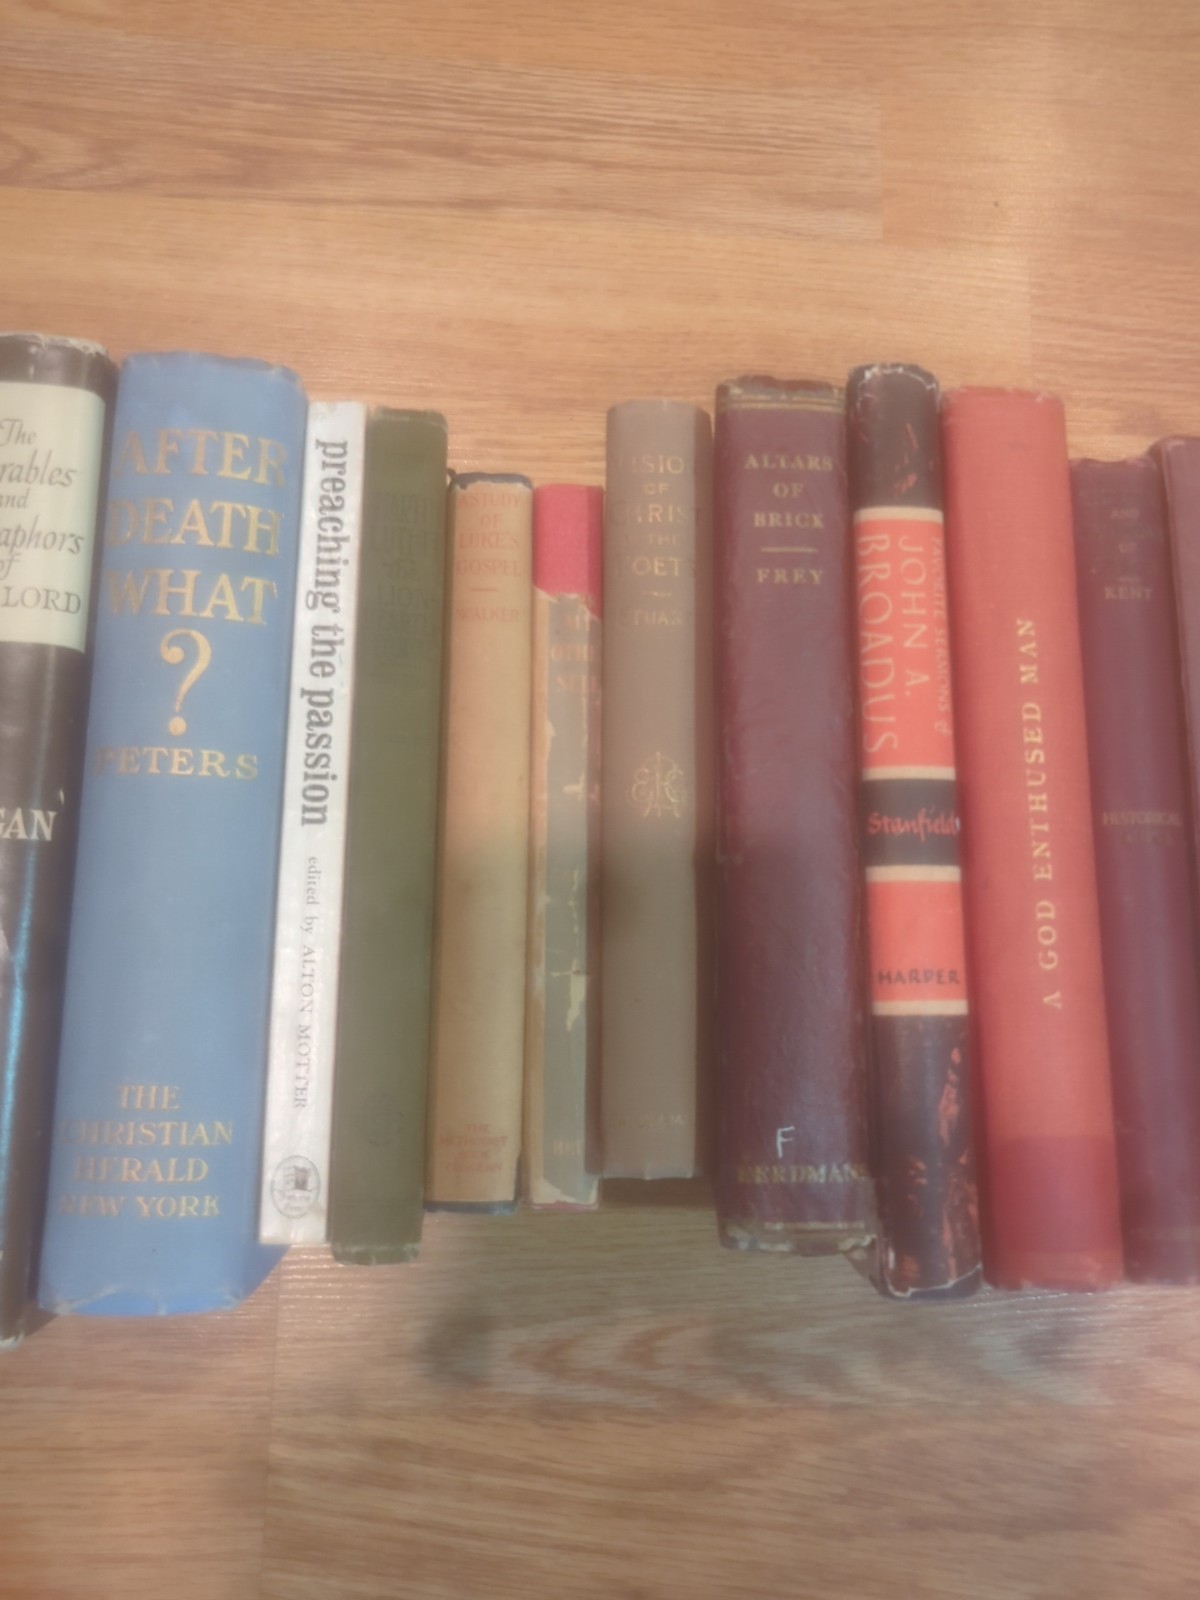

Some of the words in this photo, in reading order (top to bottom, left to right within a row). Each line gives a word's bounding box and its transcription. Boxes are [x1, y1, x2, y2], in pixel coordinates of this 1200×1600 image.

[0, 418, 37, 446] The
[112, 428, 288, 488] AFTER
[743, 453, 834, 472] ALTARS
[0, 487, 30, 509] nd
[772, 481, 804, 498] OF
[108, 498, 284, 558] DEATH
[305, 438, 350, 614] preaching
[480, 513, 503, 528] OF
[753, 512, 824, 529] BRICK
[756, 568, 823, 586] FREY
[898, 535, 929, 648] JOHN
[1, 586, 81, 614] LORD
[106, 566, 278, 625] WHAT
[309, 624, 345, 679] the
[857, 533, 898, 753] BROADUS
[1016, 617, 1039, 685] MAN
[904, 669, 930, 697] A.
[94, 746, 258, 780] PETERS
[300, 686, 338, 827] passion
[1022, 702, 1053, 882] ENTHUSED
[306, 856, 321, 906] edited
[300, 916, 319, 935] by
[1035, 899, 1060, 972] GOD
[299, 945, 316, 1013] ALTON
[877, 968, 960, 986] HARPER
[1043, 989, 1063, 1010] A
[293, 1024, 312, 1109] MOTTER
[118, 1083, 182, 1111] THE
[59, 1119, 233, 1146] CHRISTIAN
[775, 1124, 797, 1160] F
[73, 1155, 209, 1184] HERALD
[134, 1194, 222, 1219] YORK
